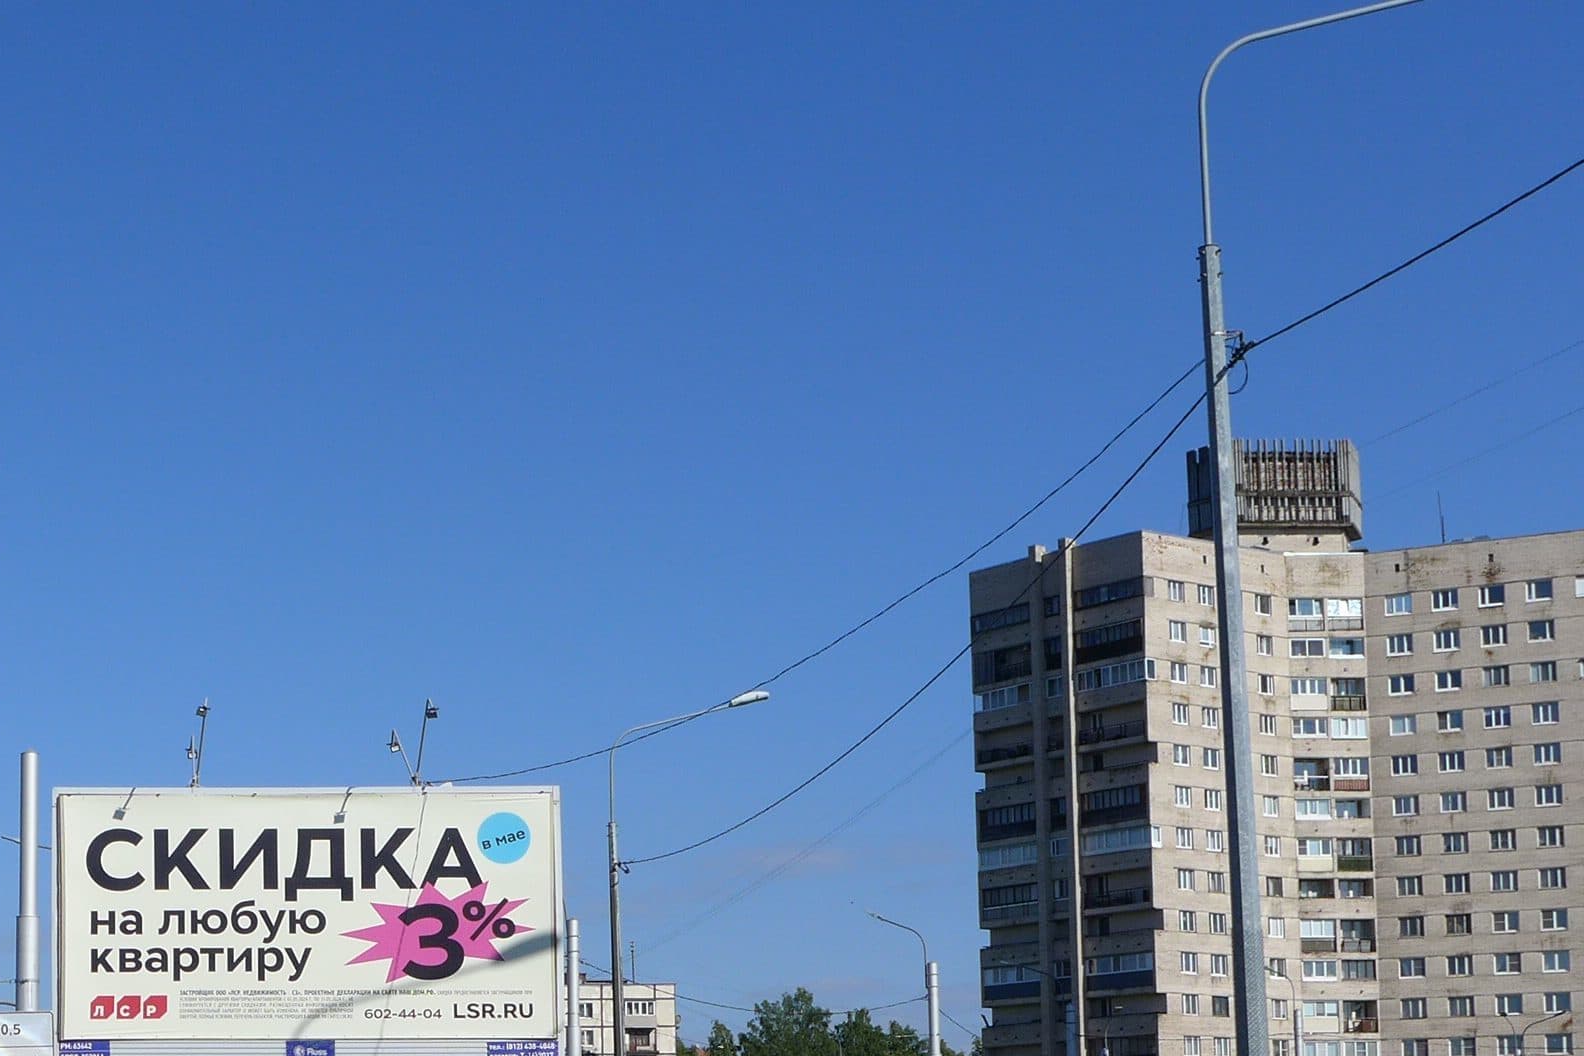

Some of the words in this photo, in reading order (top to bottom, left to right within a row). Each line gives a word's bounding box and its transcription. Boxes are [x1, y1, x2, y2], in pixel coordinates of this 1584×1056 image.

[482, 840, 492, 850] в
[495, 830, 526, 846] мае
[86, 827, 483, 901] СКИДКА
[89, 909, 143, 935] на
[158, 900, 327, 943] любую
[399, 897, 516, 980] 3%
[89, 946, 313, 981] квартиру
[364, 1008, 442, 1019] 602-44-04
[453, 1002, 534, 1019] LSR.RU
